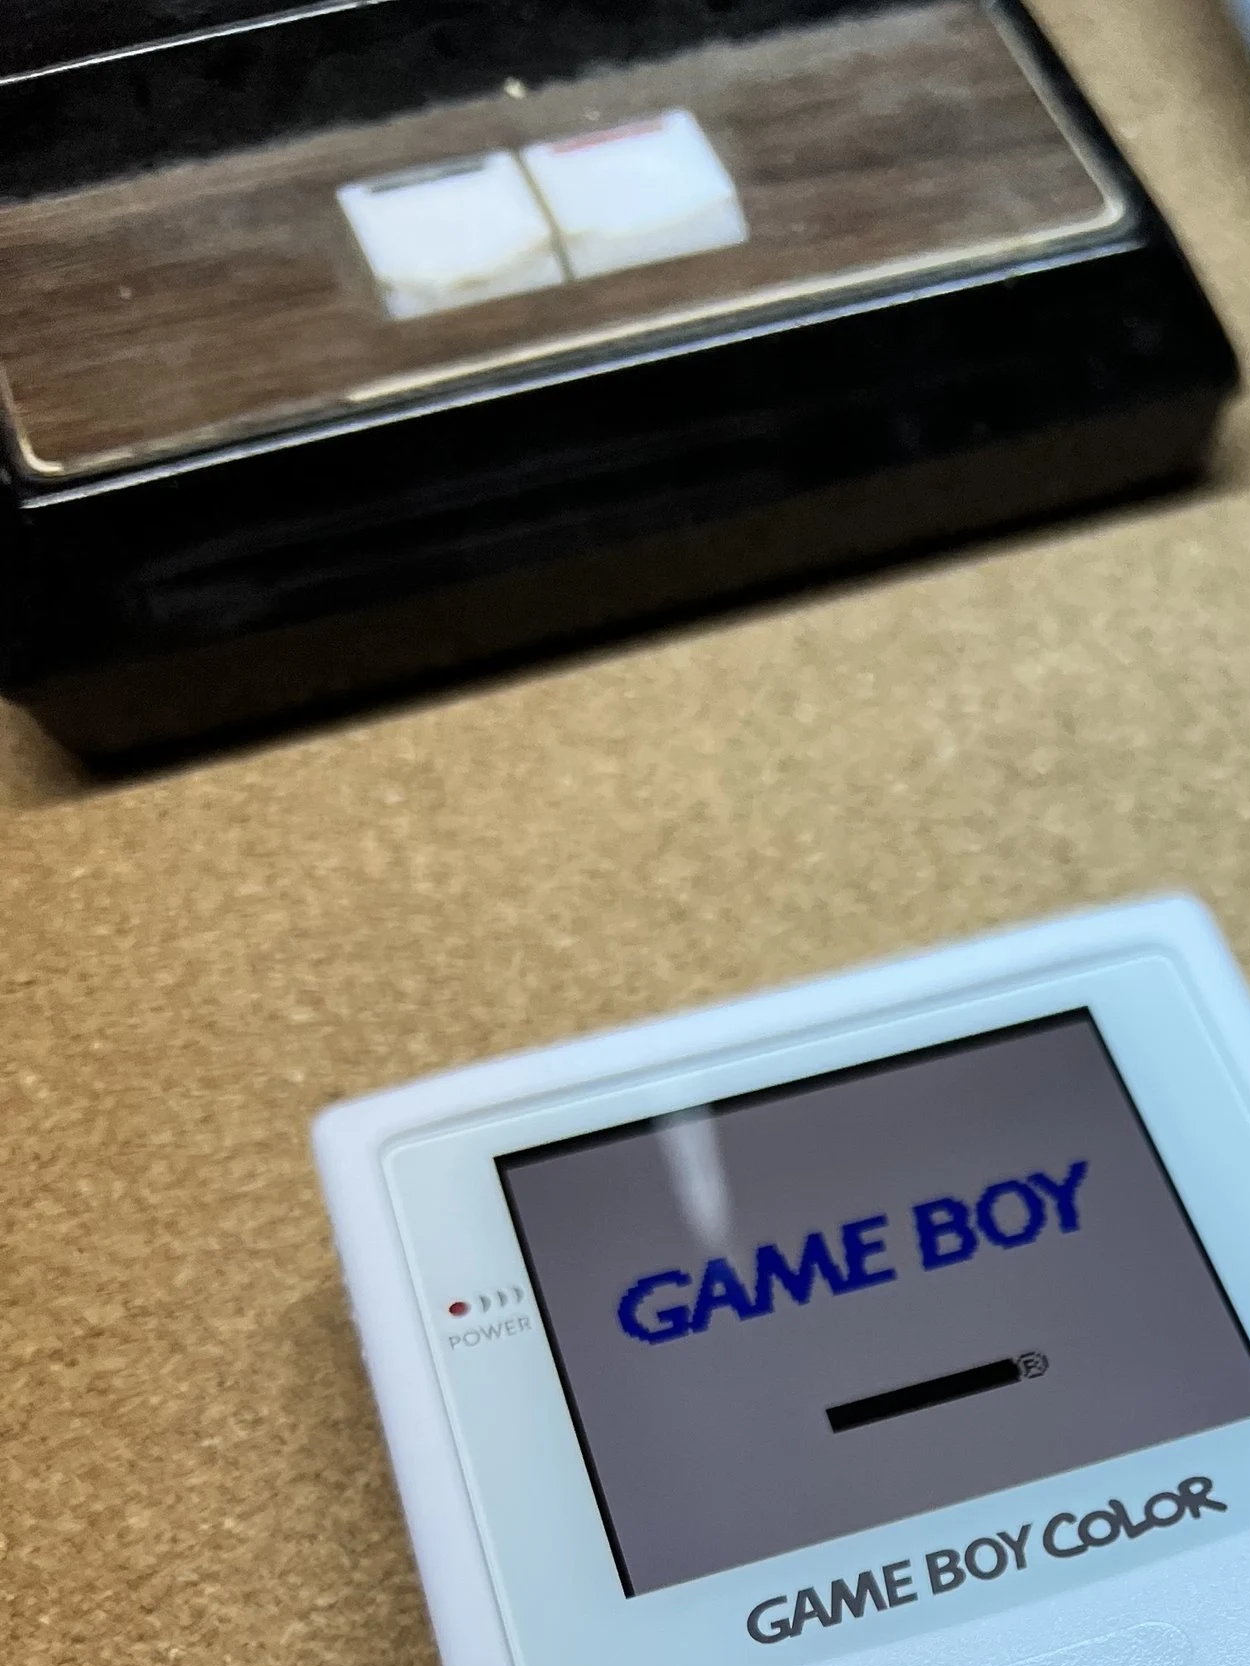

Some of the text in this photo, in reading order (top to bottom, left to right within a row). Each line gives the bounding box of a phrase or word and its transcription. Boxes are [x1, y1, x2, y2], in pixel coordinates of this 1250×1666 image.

[448, 1315, 532, 1351] POWER
[617, 1160, 1089, 1345] GAME BOY
[747, 1475, 1229, 1645] GAME BOY COLOR
